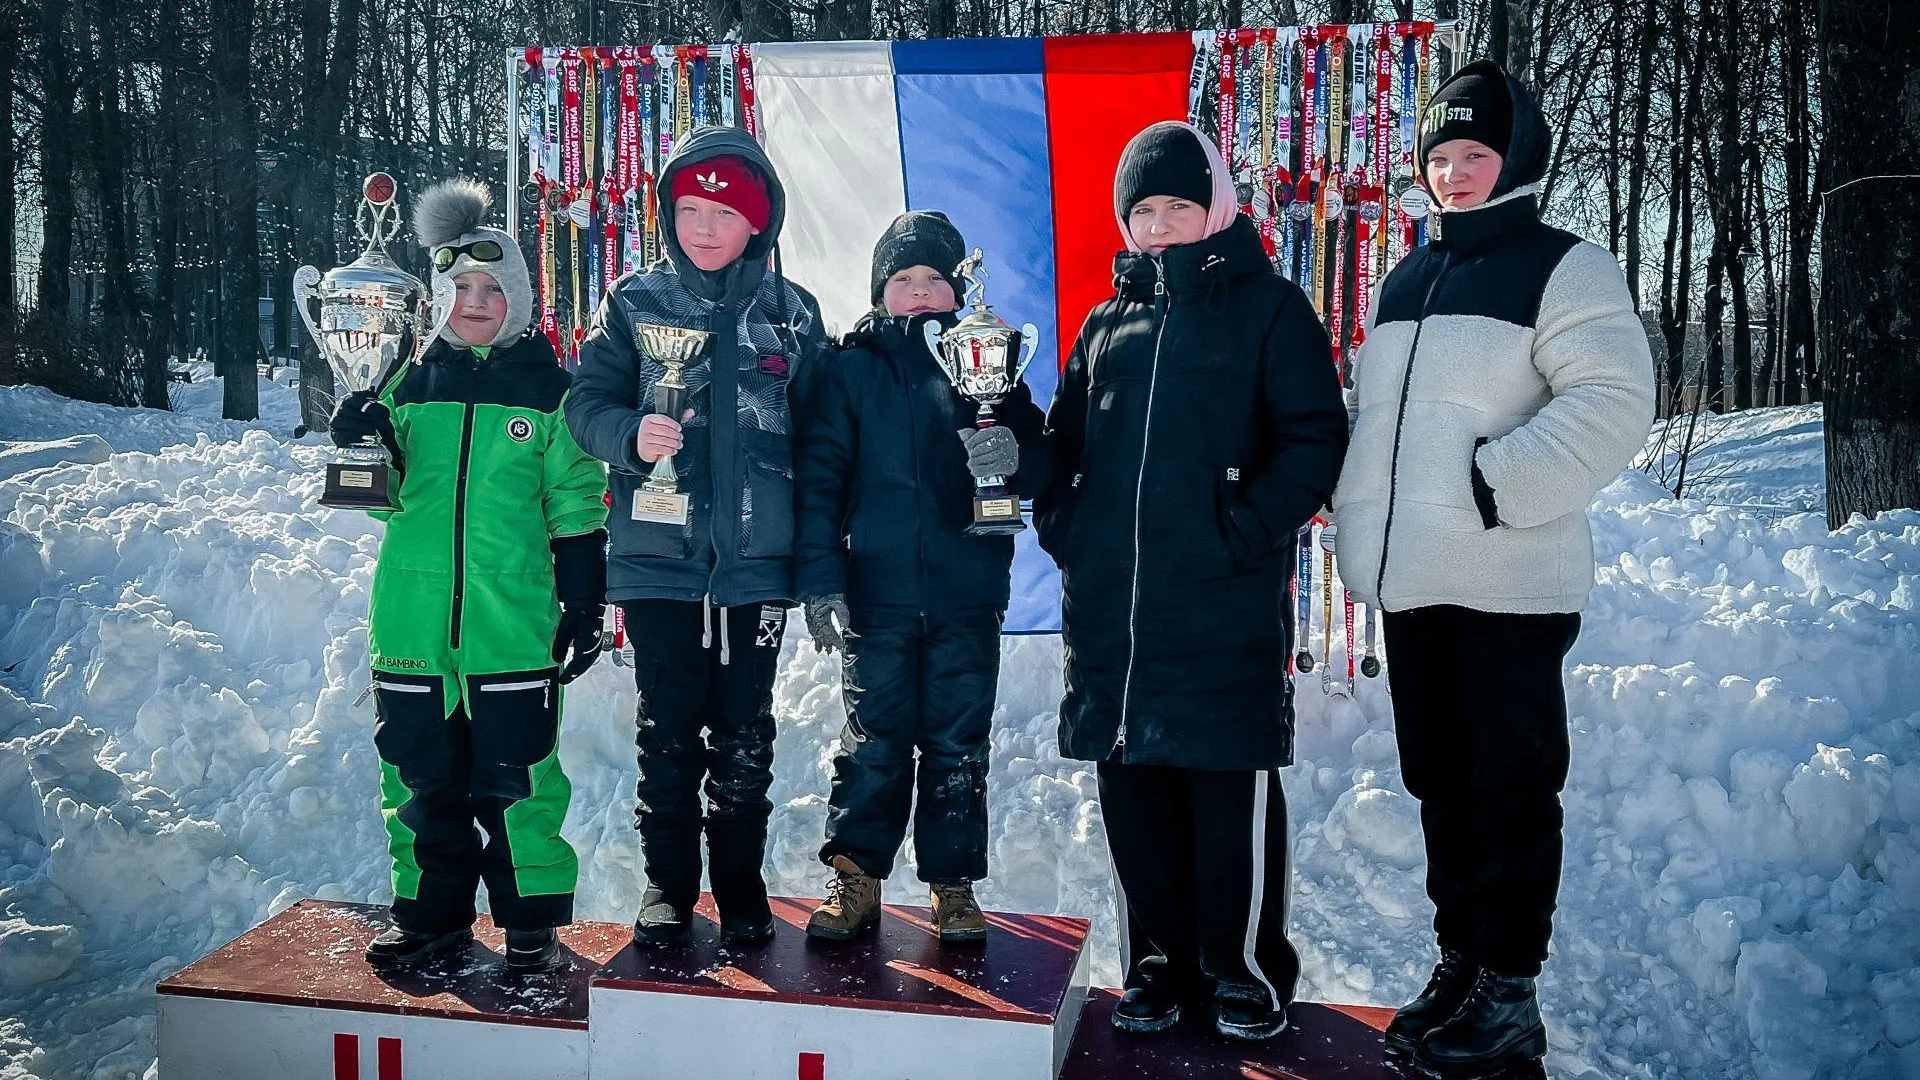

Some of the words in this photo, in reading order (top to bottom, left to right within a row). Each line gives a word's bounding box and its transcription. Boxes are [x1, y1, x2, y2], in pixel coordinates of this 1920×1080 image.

[1222, 55, 1232, 78] 2019
[1306, 48, 1315, 73] 2019
[1381, 50, 1390, 75] 2019
[569, 70, 577, 92] 2019
[626, 73, 635, 97] 2019
[741, 67, 753, 91] 2019
[1242, 69, 1251, 99] 5000
[1355, 64, 1364, 86] RACE
[1220, 94, 1229, 128] ГОНКА
[1264, 74, 1272, 132] ГРАН-ПРИ
[1304, 89, 1314, 123] ГОНКА
[1332, 69, 1341, 127] ГРАН-ПРИ
[1379, 91, 1389, 125] ГОНКА
[569, 107, 578, 138] ГОНКА
[585, 89, 593, 142] ГРАН-ПРИ
[628, 111, 637, 142] ГОНКА
[1315, 116, 1324, 124] 2
[1405, 109, 1414, 118] 2
[1447, 107, 1473, 121] STER
[546, 223, 554, 256] FINAL
[646, 231, 655, 267] FINAL
[1358, 240, 1368, 274] ГОНКА
[1299, 589, 1308, 597] 2
[615, 607, 623, 633] ОНКА
[1346, 605, 1355, 659] НАРОДНАЯ
[386, 657, 428, 669] BAMBINO
